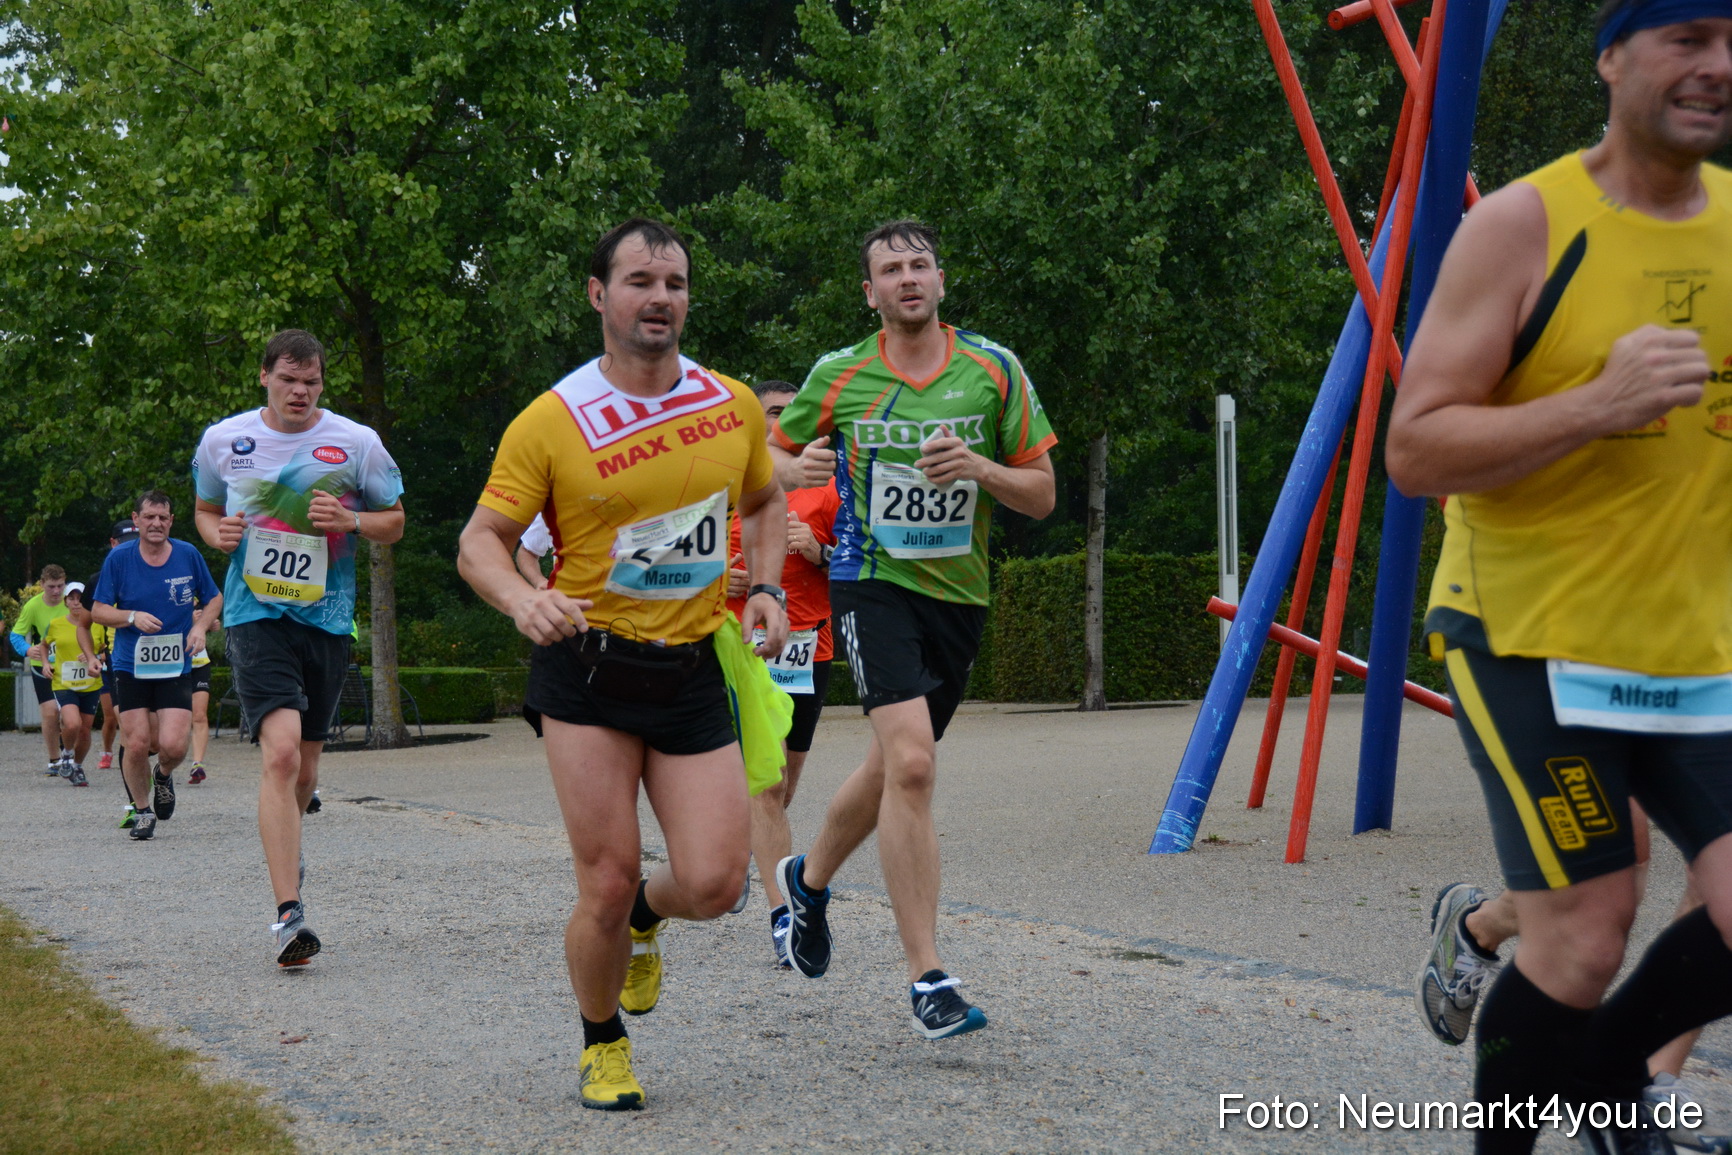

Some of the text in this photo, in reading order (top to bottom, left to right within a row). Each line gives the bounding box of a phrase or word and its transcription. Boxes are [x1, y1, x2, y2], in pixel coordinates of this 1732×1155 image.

[595, 410, 744, 480] MAX BÖGL
[231, 458, 255, 466] PARTL
[882, 485, 969, 523] 2832
[285, 535, 322, 549] BOCK
[902, 531, 943, 546] Julian
[261, 547, 312, 581] 202
[644, 570, 691, 586] Marco
[266, 582, 300, 598] Tobias
[140, 645, 180, 663] 3020
[71, 668, 86, 680] 70
[769, 671, 795, 684] obert
[1609, 683, 1678, 709] Alfred
[1559, 765, 1608, 828] Run!
[1550, 799, 1579, 845] Team
